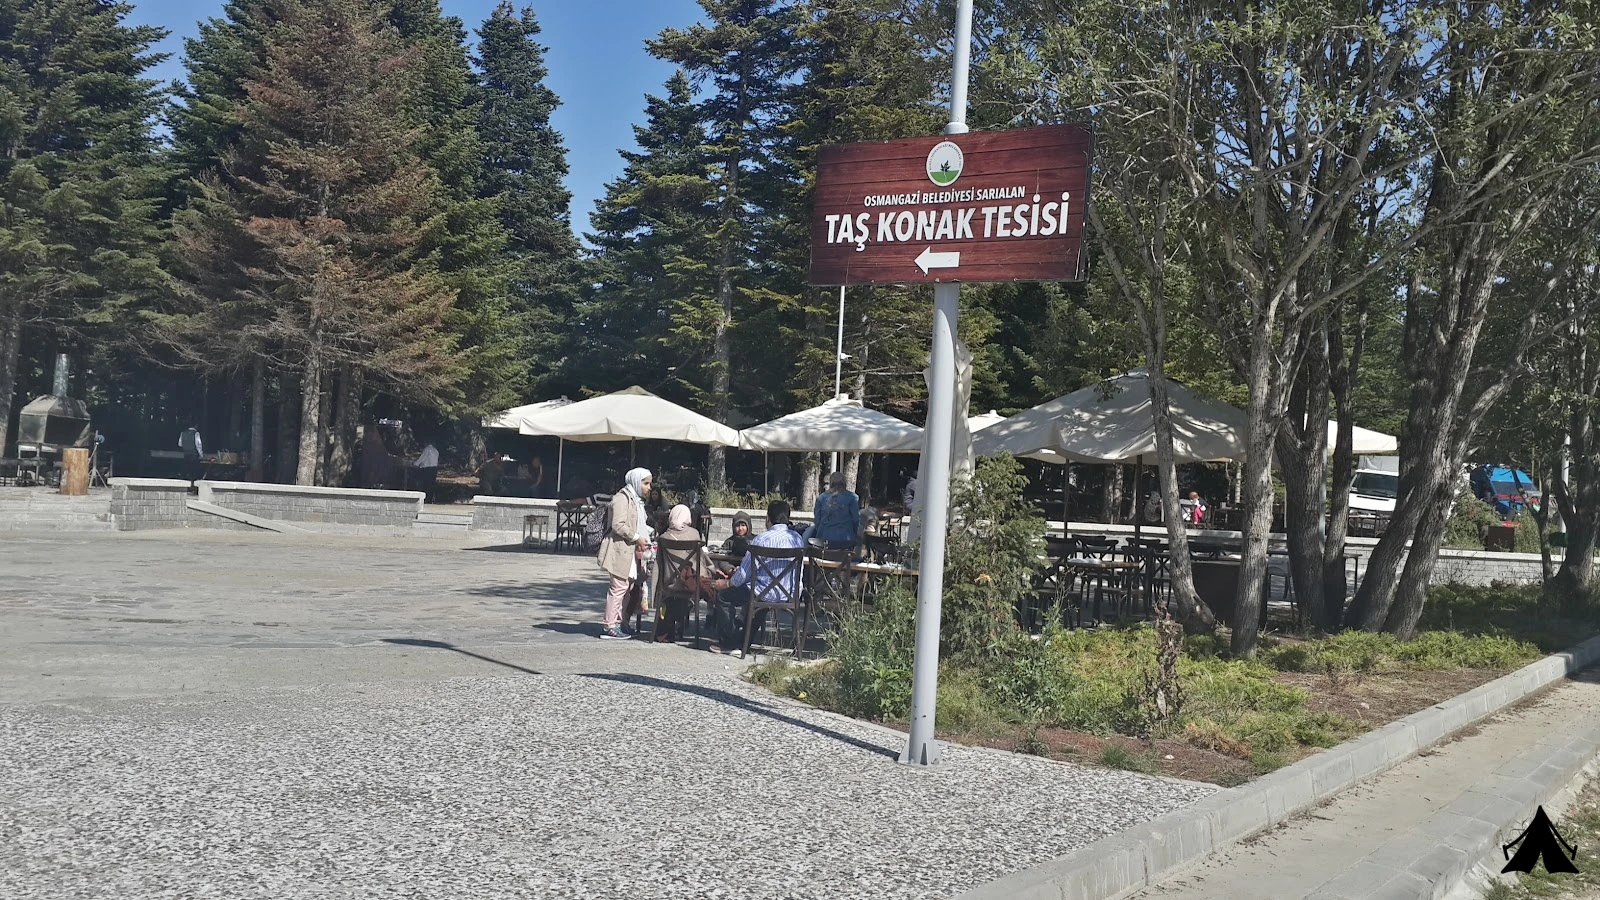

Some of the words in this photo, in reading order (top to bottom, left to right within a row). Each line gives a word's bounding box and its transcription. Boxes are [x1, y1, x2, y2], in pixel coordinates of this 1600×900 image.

[864, 190, 920, 207] OSMANGAZİ
[922, 186, 975, 204] BELEDİYESİ
[976, 186, 1025, 201] SARIALAN
[825, 212, 871, 251] TAŞ
[877, 207, 976, 242] KONAK
[981, 191, 1070, 238] TESİSİ
